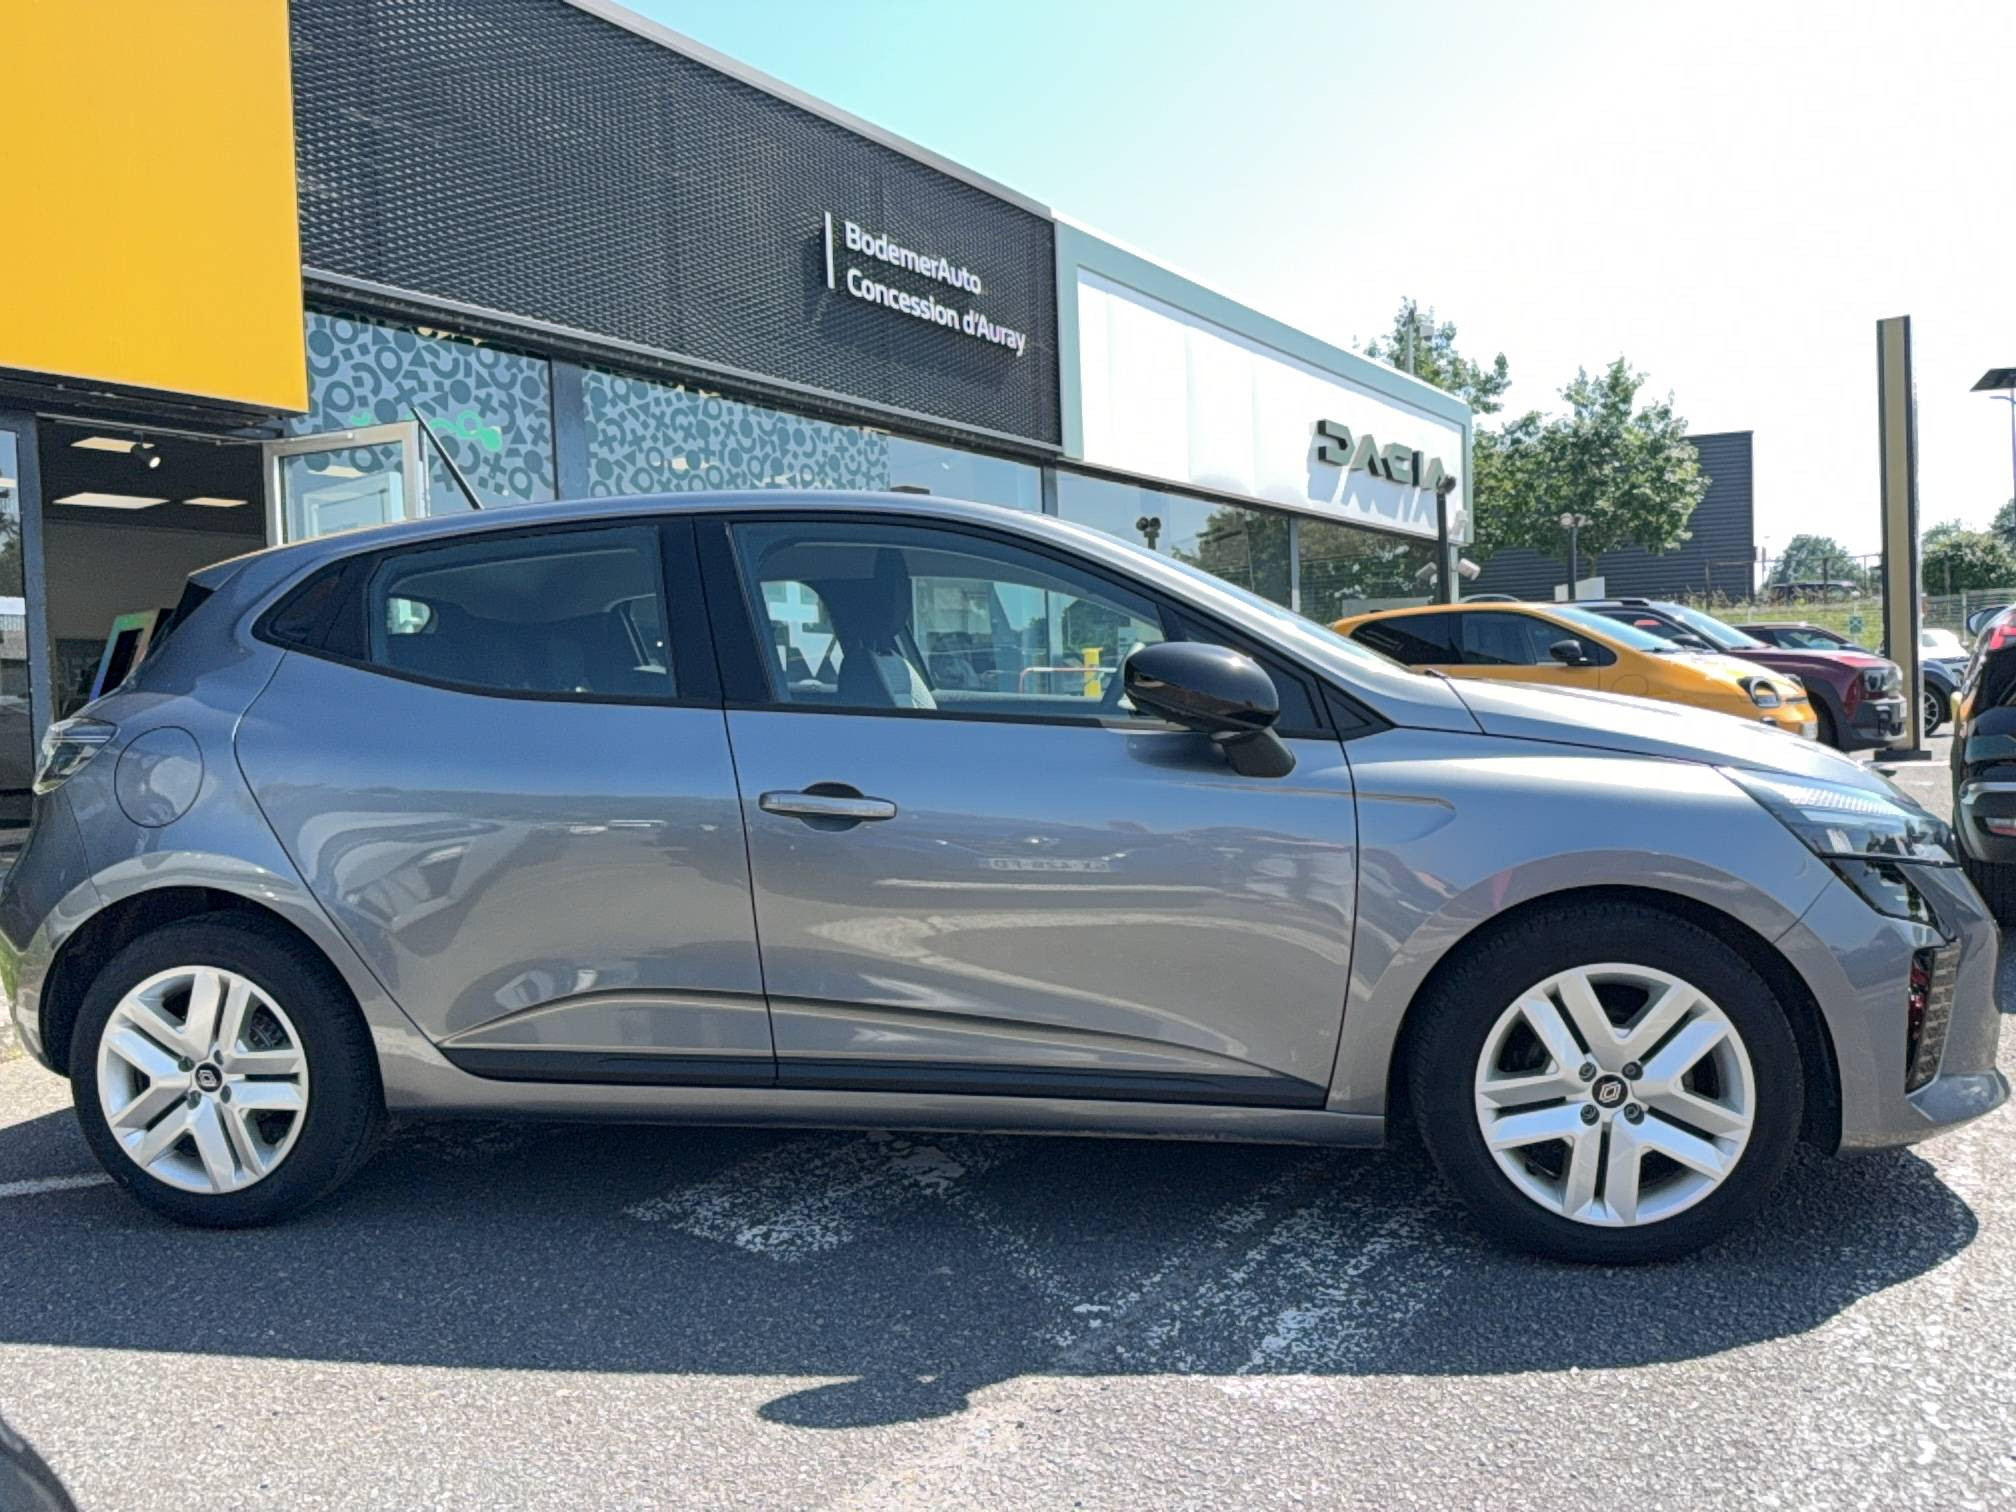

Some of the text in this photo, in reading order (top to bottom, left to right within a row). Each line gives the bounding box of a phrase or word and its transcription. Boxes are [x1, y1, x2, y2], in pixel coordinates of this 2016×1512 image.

[844, 221, 982, 295] BodemerAuto
[847, 268, 1027, 357] Concession d'Auray
